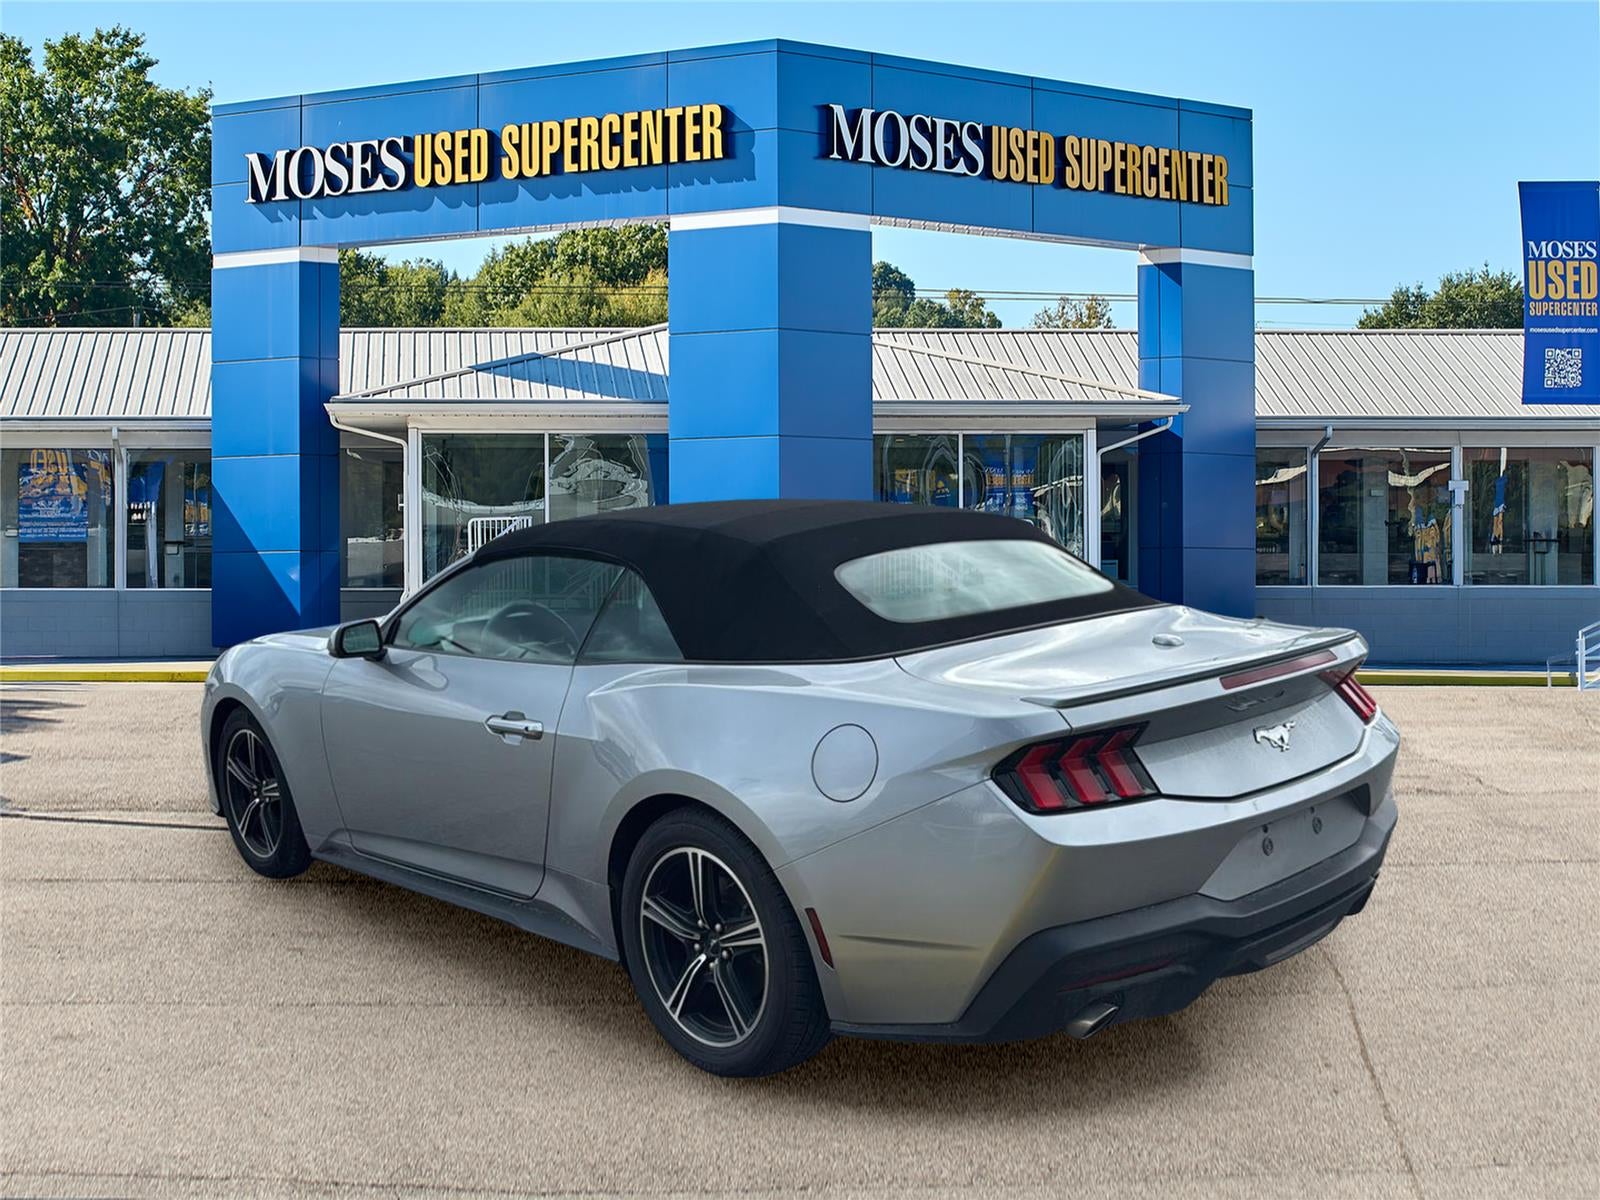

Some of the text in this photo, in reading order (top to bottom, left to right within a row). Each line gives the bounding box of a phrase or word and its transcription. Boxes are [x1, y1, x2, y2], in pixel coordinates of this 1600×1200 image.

[244, 103, 724, 204] MOSES USED SUPERCENTER
[828, 103, 1230, 206] MOSES USED SUPERCENTER
[1528, 241, 1597, 259] MOSES
[1527, 260, 1598, 300] USED
[1529, 301, 1598, 316] SUPERCENTER
